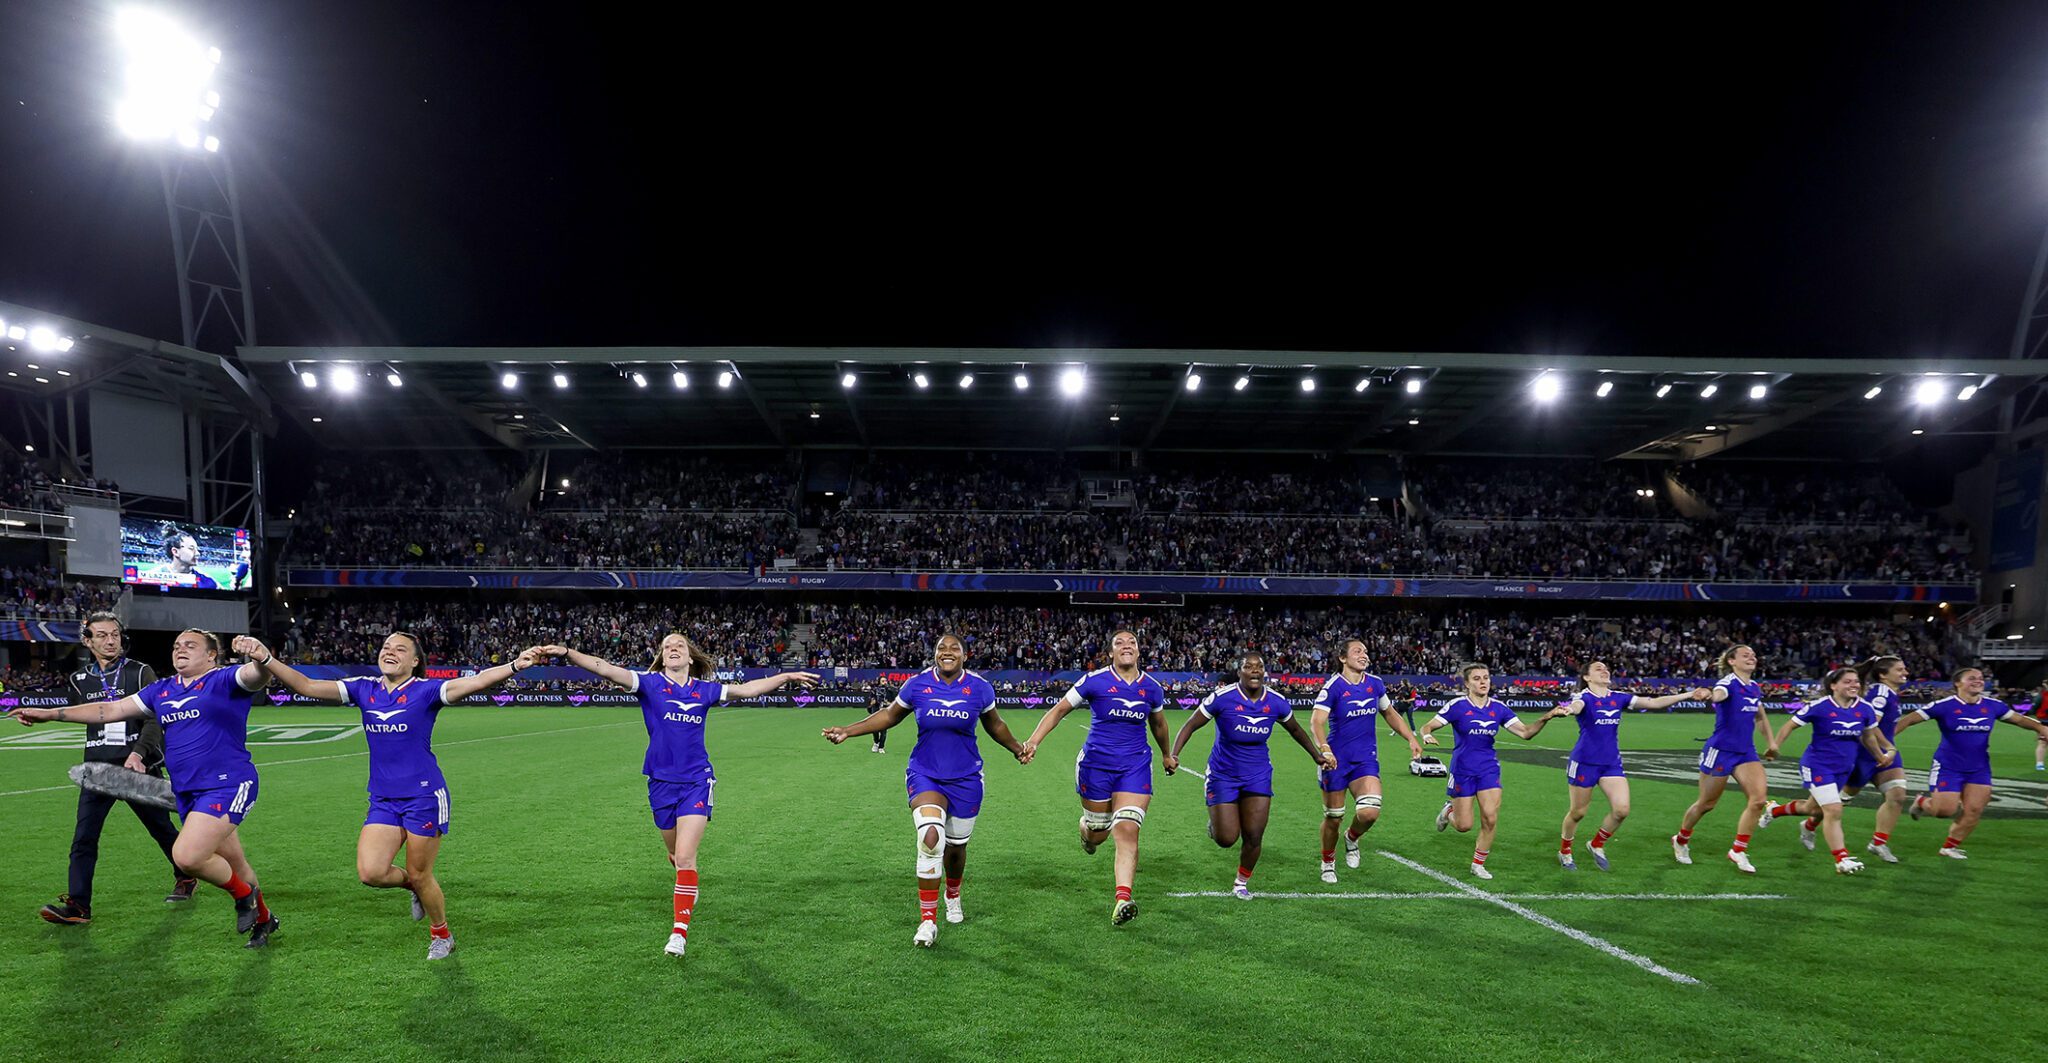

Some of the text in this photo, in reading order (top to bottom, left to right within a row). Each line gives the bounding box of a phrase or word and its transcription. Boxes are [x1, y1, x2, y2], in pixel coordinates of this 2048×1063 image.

[425, 669, 459, 678] FRANCE
[21, 696, 69, 706] GREATNESS
[516, 694, 562, 702] GREATNESS
[591, 694, 639, 702] GREATNESS
[817, 694, 865, 703] GREATNESS
[1506, 698, 1554, 708] GREATNESS
[161, 709, 200, 724] ALTRAD
[664, 711, 703, 724] ALTRAD
[926, 708, 969, 720] ALTRAD
[1108, 708, 1145, 720] ALTRAD
[1347, 707, 1377, 718] ALTRAD
[365, 723, 408, 733] ALTRAD
[1234, 724, 1270, 735] ALTRAD
